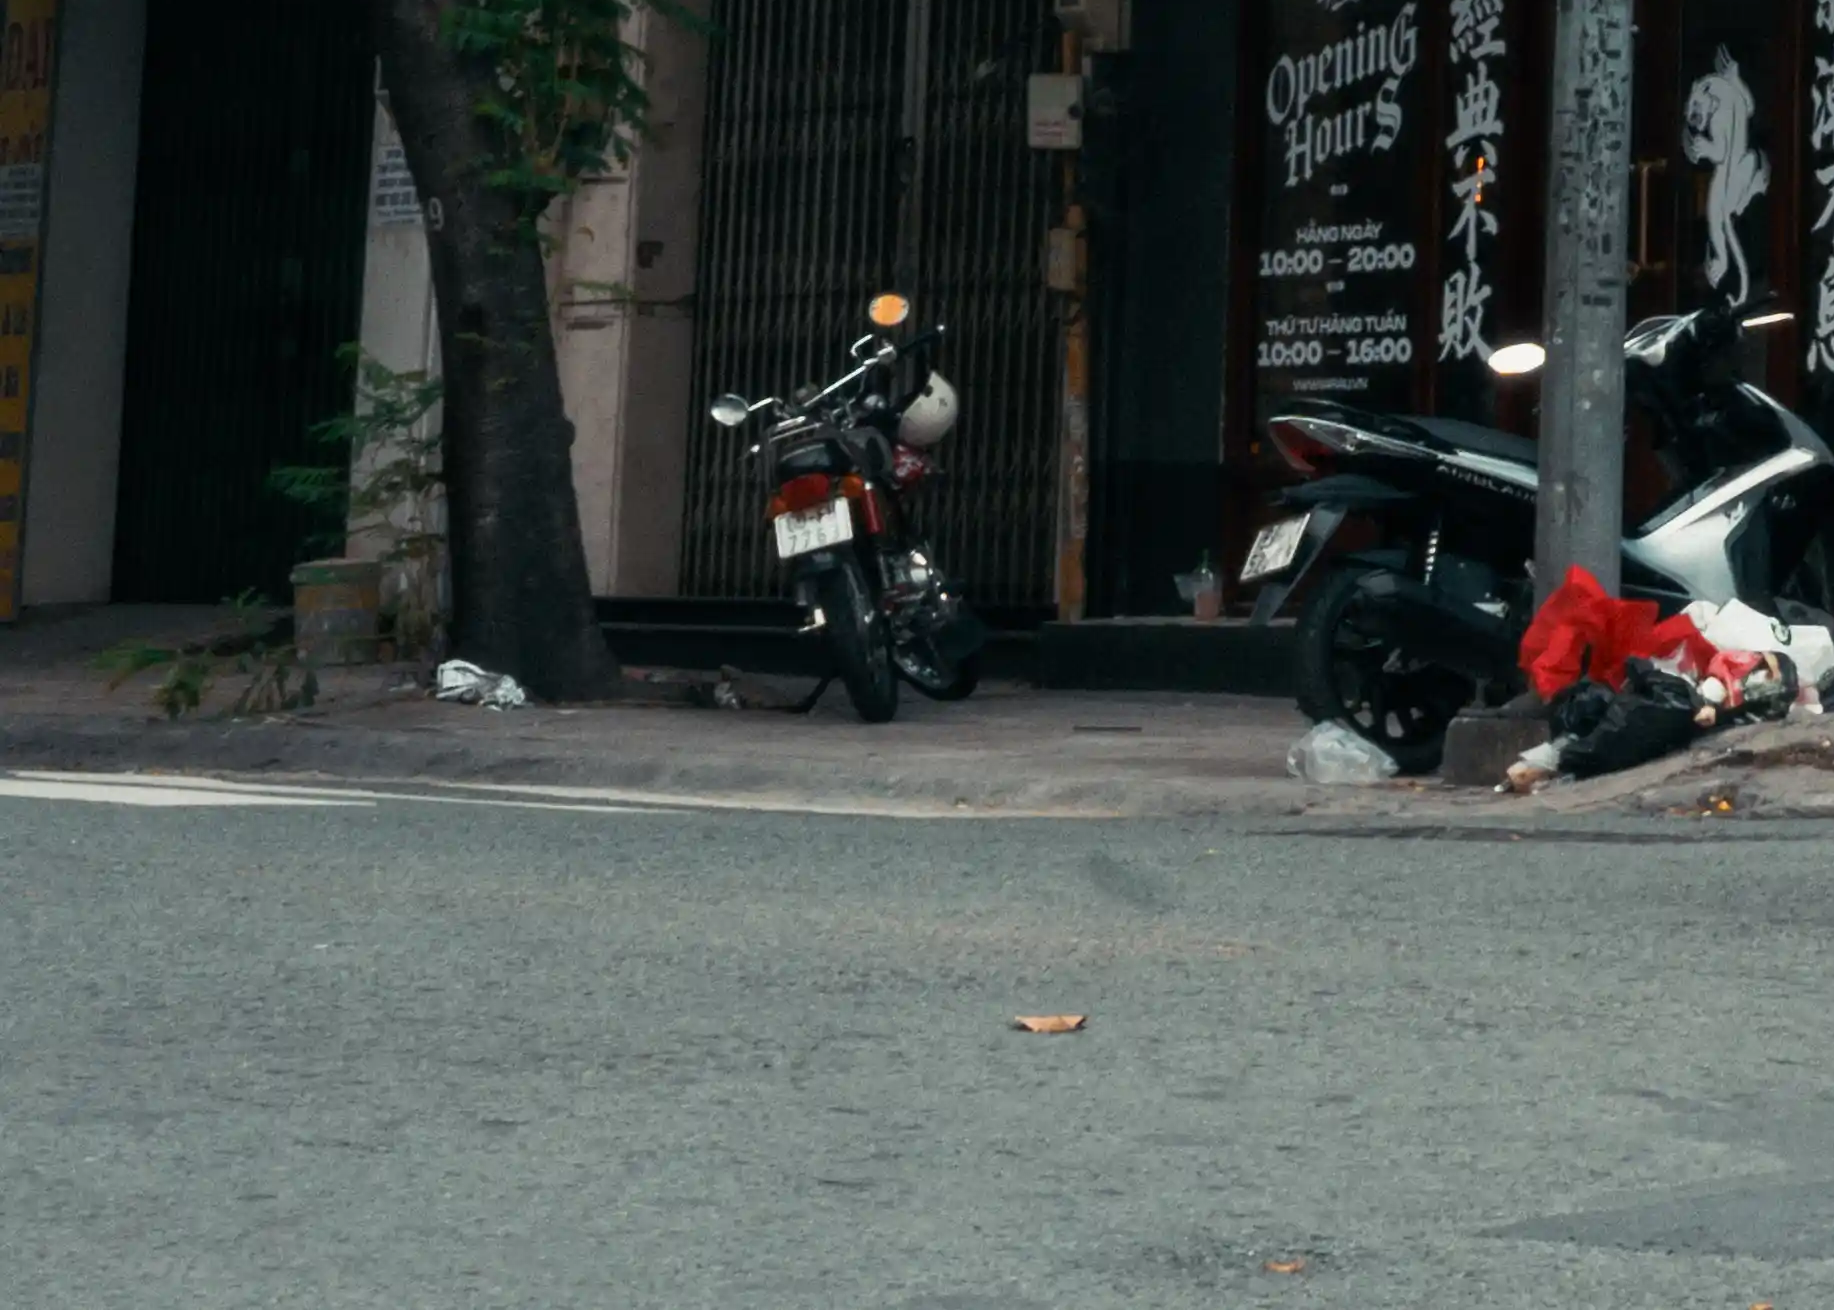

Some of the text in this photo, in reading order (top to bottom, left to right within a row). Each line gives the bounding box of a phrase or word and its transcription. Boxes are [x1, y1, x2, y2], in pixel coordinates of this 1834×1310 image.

[1341, 216, 1384, 242] NGÀY
[1258, 248, 1324, 277] 10:00
[1346, 242, 1416, 273] 20:00
[1256, 339, 1323, 368] 10:00
[1344, 336, 1414, 367] 16:00
